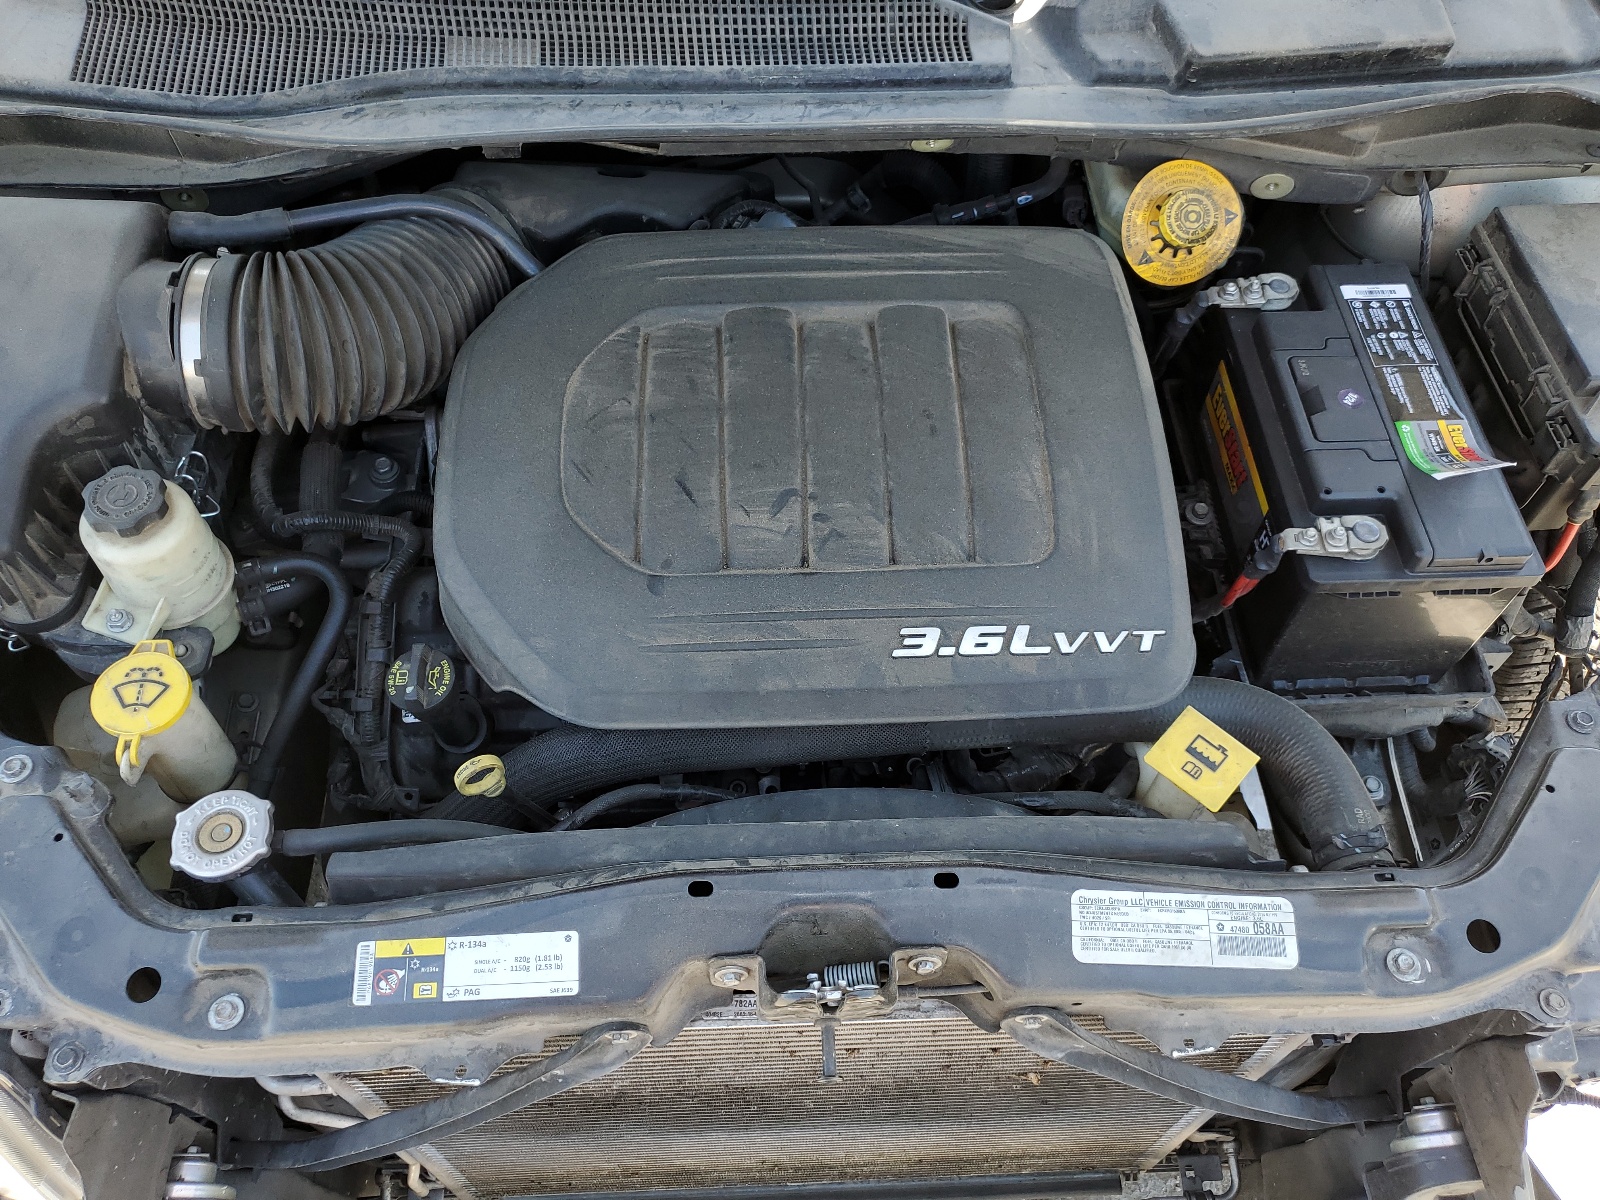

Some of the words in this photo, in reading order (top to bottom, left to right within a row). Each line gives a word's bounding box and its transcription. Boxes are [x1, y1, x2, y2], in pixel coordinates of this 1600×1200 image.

[1211, 382, 1248, 488] EverStart
[891, 624, 1051, 658] 3.6L
[1053, 630, 1167, 654] VVT
[390, 660, 402, 674] SAE
[440, 659, 451, 685] ENGINE
[434, 685, 447, 697] OIL
[194, 796, 229, 816] KEEP
[1354, 808, 1366, 824] RAD
[204, 853, 238, 869] OPEN
[239, 834, 258, 857] HOT
[1078, 896, 1108, 906] Chrysler
[1130, 898, 1144, 906] LLC
[1145, 898, 1173, 907] VEHICLE
[1174, 900, 1206, 908] EMISSION
[1208, 900, 1237, 910] CONTROL
[1238, 902, 1282, 911] INFORMATION
[1230, 926, 1250, 934] 47480
[1253, 922, 1284, 935] 058AA
[460, 940, 487, 949] R-134a
[514, 956, 531, 964] 820g
[553, 953, 563, 962] lb)
[535, 964, 552, 972] (2.53
[554, 962, 563, 971] lb)
[464, 988, 481, 996] PAG
[734, 1000, 758, 1008] 782AA
